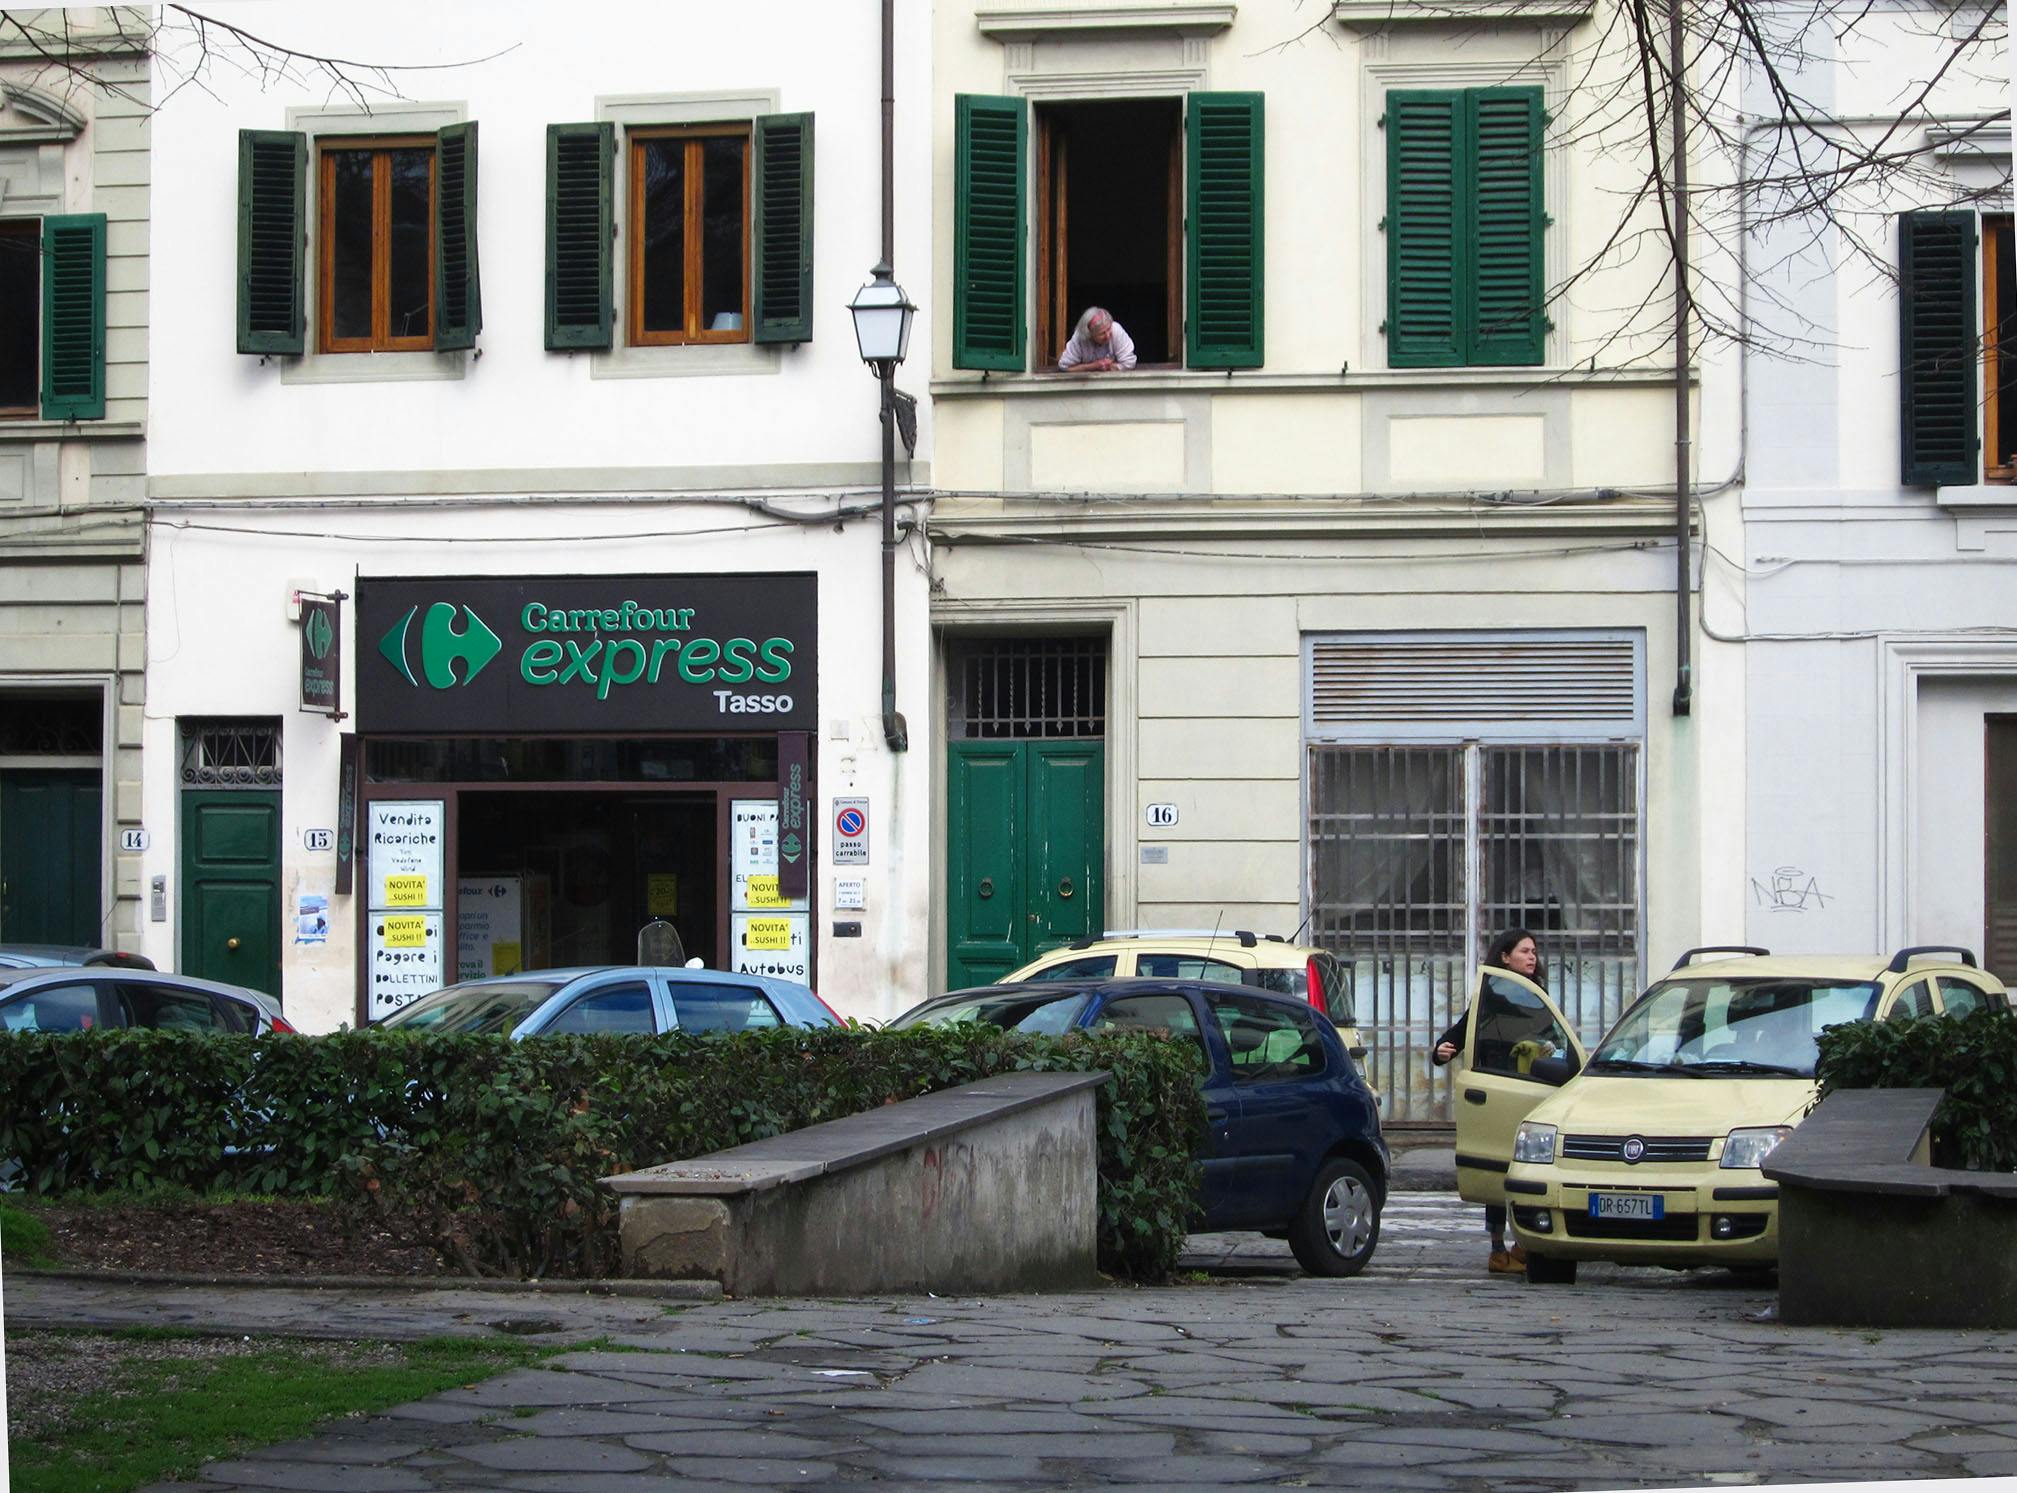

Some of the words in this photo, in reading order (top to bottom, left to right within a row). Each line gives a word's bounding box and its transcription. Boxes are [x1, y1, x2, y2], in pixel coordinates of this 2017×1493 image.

[520, 600, 696, 633] Carrefour
[520, 637, 795, 700] express
[713, 690, 794, 713] Tasso
[790, 763, 804, 829] express
[379, 813, 432, 826] Vendita
[737, 814, 766, 822] BUONI
[1152, 807, 1172, 823] 16
[127, 832, 142, 848] 14
[310, 832, 328, 848] 15
[374, 832, 436, 845] Ricariche
[835, 849, 867, 857] carrabile
[840, 842, 862, 850] passo
[752, 884, 780, 892] NOVIT
[377, 950, 425, 966] Pagare
[740, 963, 804, 976] Autobus
[376, 974, 438, 984] BOLLETTINI
